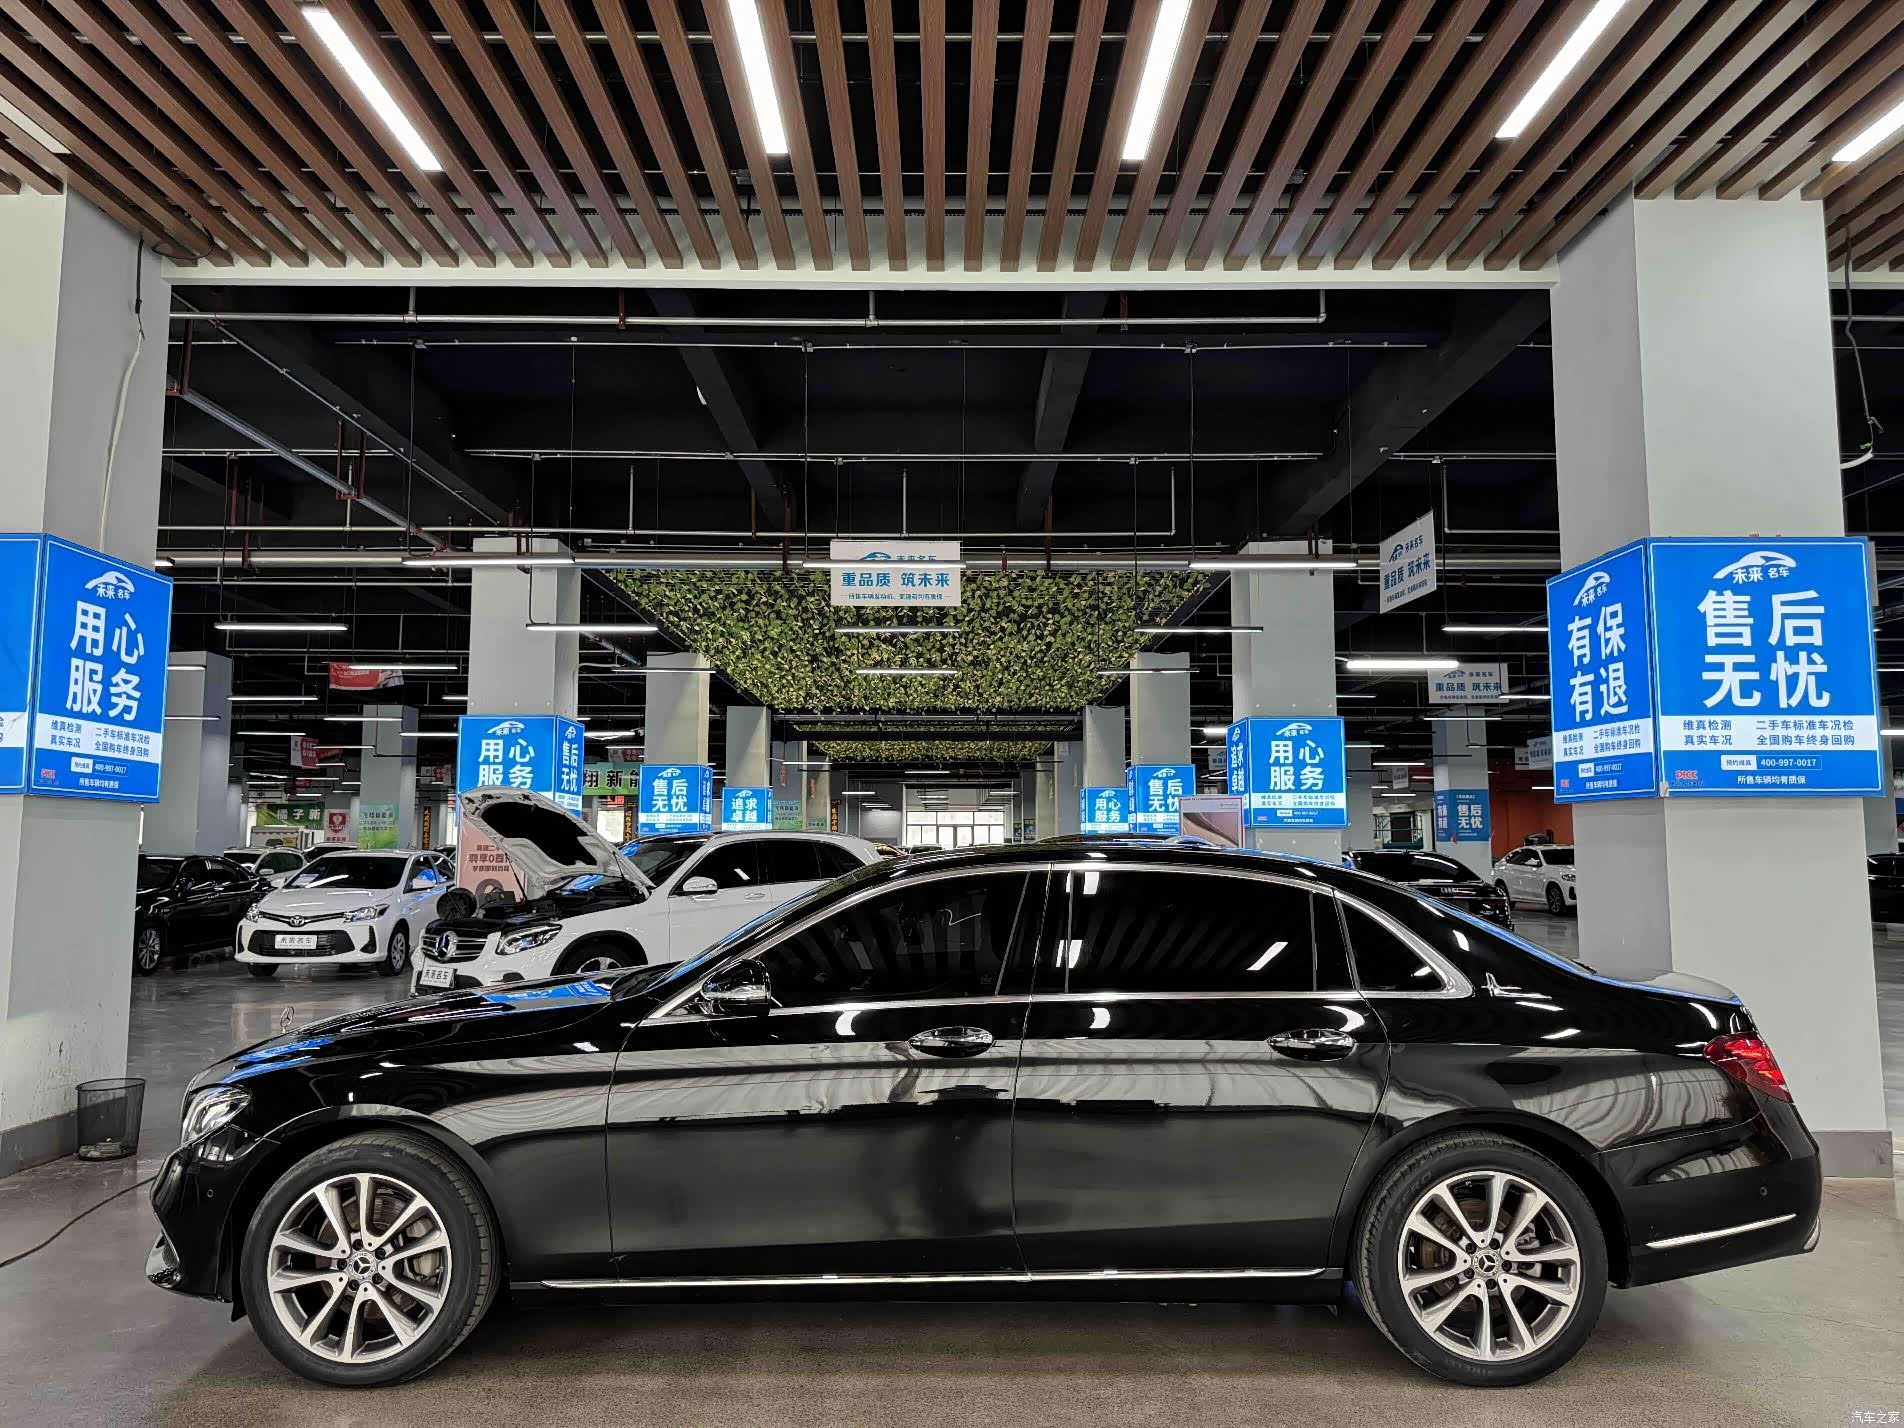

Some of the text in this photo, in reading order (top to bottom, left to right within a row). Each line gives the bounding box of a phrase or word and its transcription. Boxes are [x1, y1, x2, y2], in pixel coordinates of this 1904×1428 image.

[841, 572, 950, 587] 重品质 筑未来
[1697, 589, 1825, 647] 售后
[70, 600, 145, 665] 用心
[1567, 602, 1626, 668] 有保
[1435, 682, 1502, 691] 重品质 筑未来
[1701, 651, 1831, 709] 无忧
[65, 657, 142, 722] 服务
[1569, 661, 1629, 723] 有退
[1683, 719, 1854, 731] 维真检测 二手车标准车况检
[50, 734, 81, 748] 真实车况
[1684, 734, 1855, 746] 真实车况 全国购车终身回购
[478, 738, 535, 763] 用心
[1269, 739, 1325, 764] 用心
[1760, 758, 1817, 767] 400-997-0017
[477, 764, 534, 789] 服务
[1269, 765, 1325, 790] 服务
[1737, 775, 1806, 785] 所售车辆均有质保
[652, 778, 688, 796] 售后
[1148, 778, 1183, 796] 售后
[652, 795, 688, 812] 无忧
[731, 797, 757, 810] 追求
[1095, 798, 1121, 810] 用心
[1148, 796, 1180, 812] 无忧
[1457, 804, 1482, 816] 售后
[1095, 810, 1121, 823] 服务
[1457, 817, 1483, 828] 无忧
